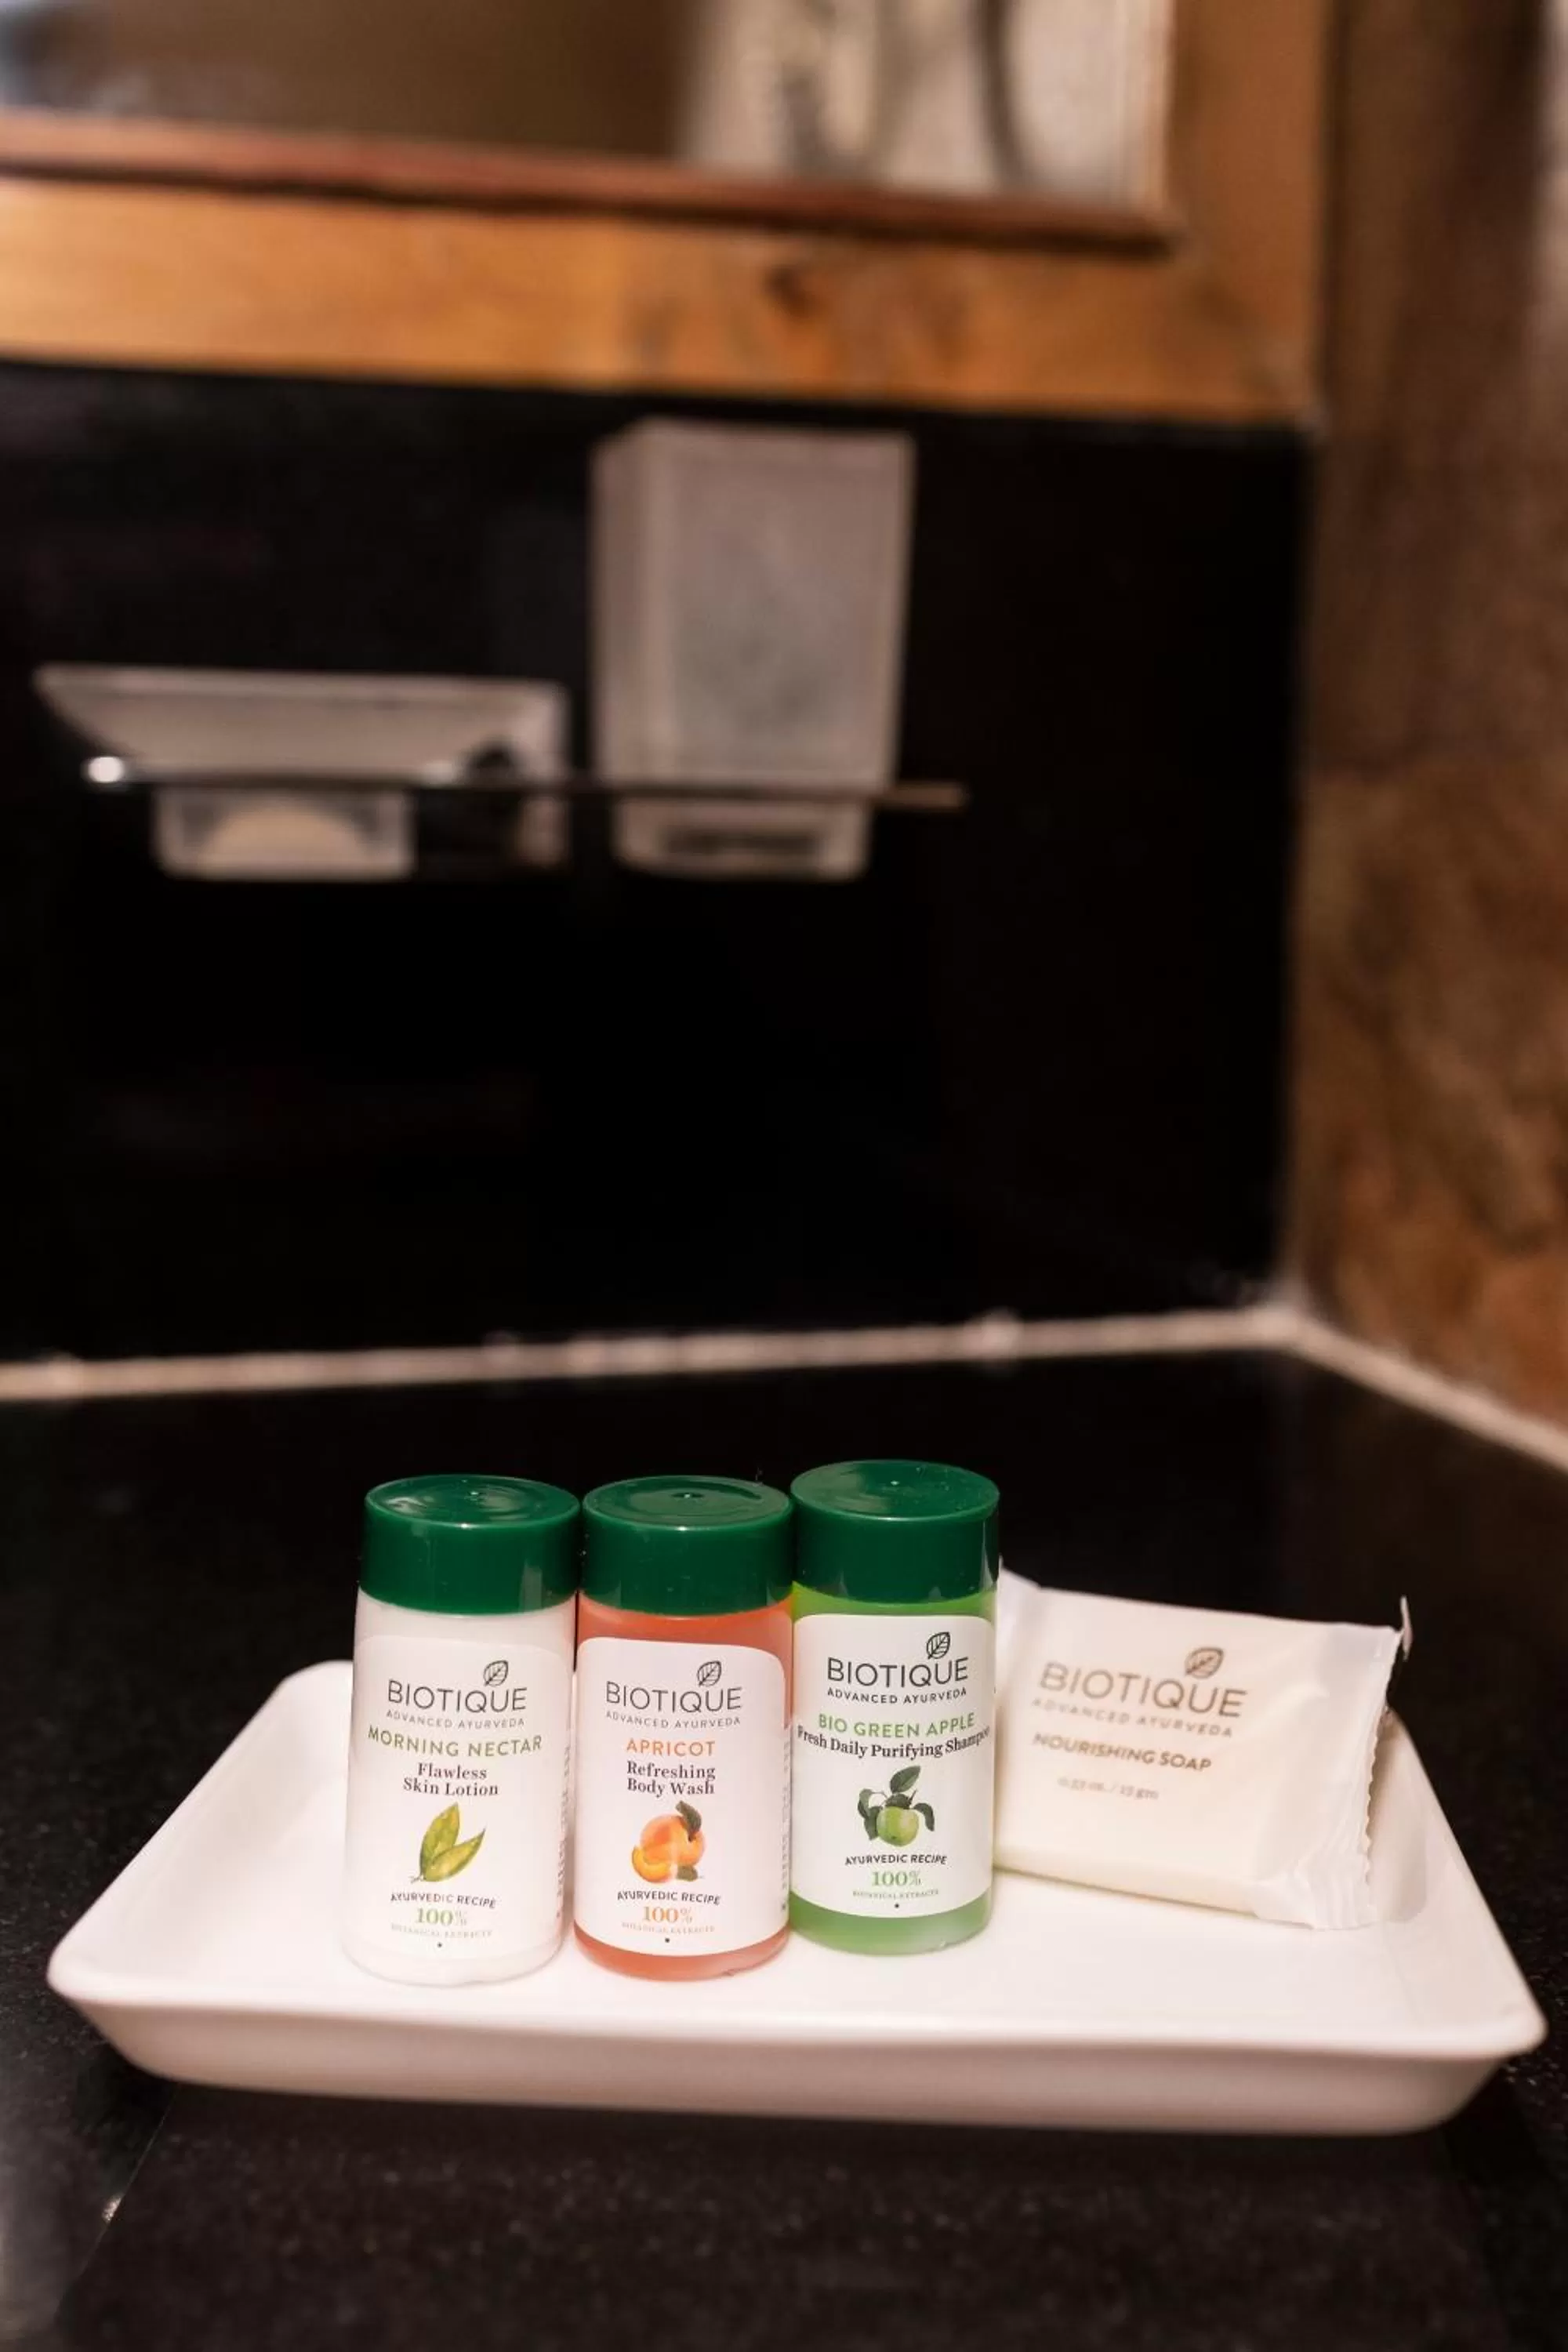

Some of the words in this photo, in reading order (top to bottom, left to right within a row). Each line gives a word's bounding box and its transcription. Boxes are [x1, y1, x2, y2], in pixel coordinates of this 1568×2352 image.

[827, 1657, 969, 1687] BIOTIQUE
[387, 1679, 527, 1713] BIOTIQUE
[606, 1681, 742, 1713] BIOTIQUE
[827, 1686, 898, 1704] ADVANCED
[903, 1686, 967, 1704] AYURVEDA
[1039, 1660, 1248, 1718] BIOTIQUE
[386, 1710, 452, 1729] ADVANCED
[458, 1717, 525, 1730] AYURVEDA
[606, 1710, 669, 1729] ADVANCED
[674, 1716, 741, 1729] AYURVEDA
[818, 1713, 848, 1733] BIO
[854, 1723, 920, 1738] GREEN
[926, 1711, 975, 1737] APPLE
[368, 1725, 459, 1756] MORNING
[468, 1735, 543, 1757] NECTAR
[626, 1737, 716, 1757] APRICOT
[797, 1725, 826, 1750] Fresh
[829, 1737, 868, 1759] Daily
[871, 1743, 943, 1760] Purifying
[1033, 1731, 1156, 1766] NOURISHING
[1159, 1750, 1212, 1773] SOAP
[418, 1762, 488, 1780] Flawless
[627, 1760, 716, 1780] Refreshing
[402, 1777, 440, 1795] Skin
[445, 1782, 499, 1797] Lotion
[627, 1777, 666, 1798] Body
[670, 1780, 715, 1795] Wash
[844, 1854, 907, 1866] AYURVEDIC
[911, 1854, 947, 1865] RECIPE
[872, 1870, 922, 1887] 100%
[390, 1892, 454, 1904] AYURVEDIC
[456, 1894, 496, 1909] RECIPE
[617, 1889, 677, 1901] AYURVEDIC
[681, 1891, 721, 1906] RECIPE
[415, 1907, 468, 1926] 100%
[642, 1905, 693, 1925] 100%
